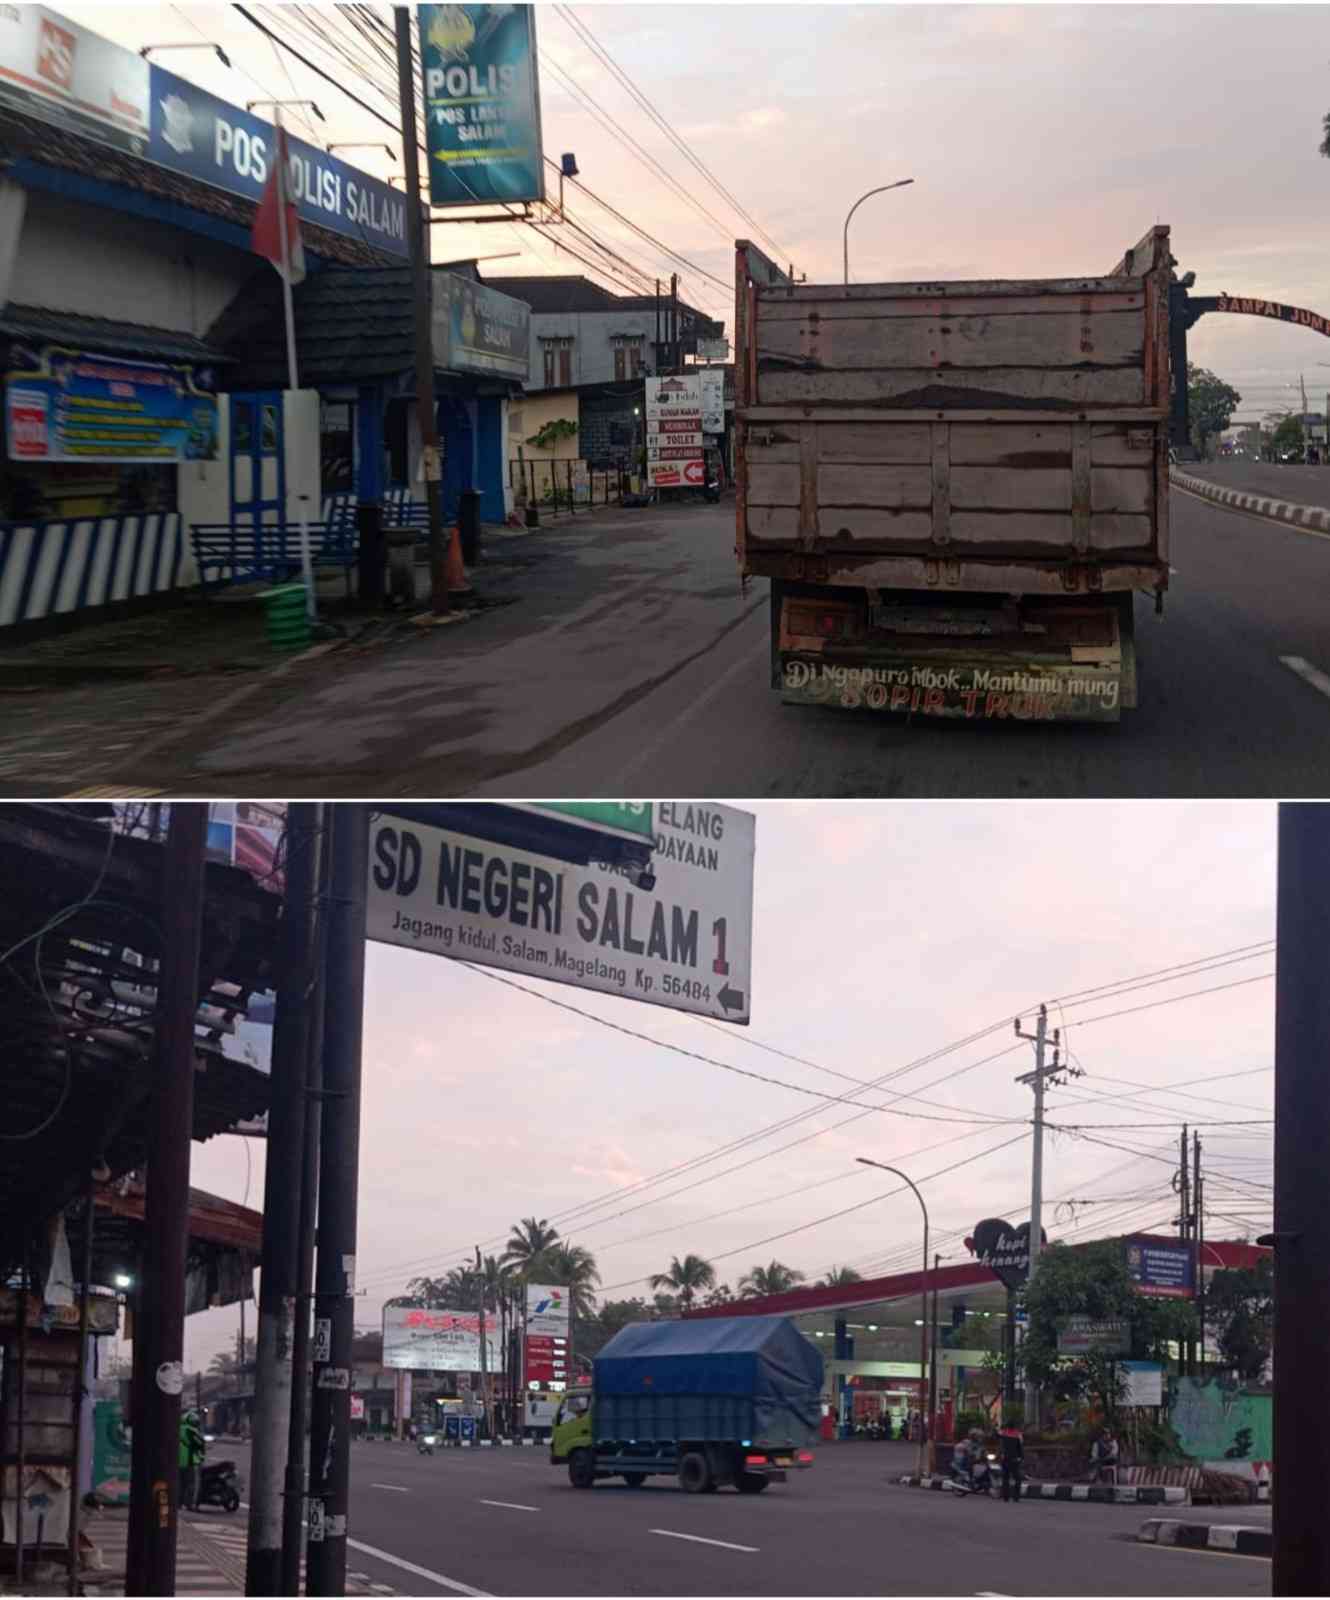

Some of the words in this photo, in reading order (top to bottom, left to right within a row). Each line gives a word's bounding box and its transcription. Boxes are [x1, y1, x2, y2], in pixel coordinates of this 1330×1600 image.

[213, 117, 267, 185] POS
[287, 155, 342, 214] OLISI
[346, 180, 404, 241] SALAM
[1217, 298, 1282, 318] SAMPAI
[666, 434, 696, 446] TOILET
[1067, 677, 1119, 709] mung
[658, 802, 724, 840] ELANG
[655, 833, 718, 871] DAYAAN
[373, 825, 422, 897] SD
[437, 840, 563, 935] NEGERI
[576, 880, 699, 968] SALAM
[712, 916, 730, 975] 1
[391, 910, 454, 950] Jagang
[554, 946, 627, 988] Magelang
[662, 974, 712, 1003] 56484
